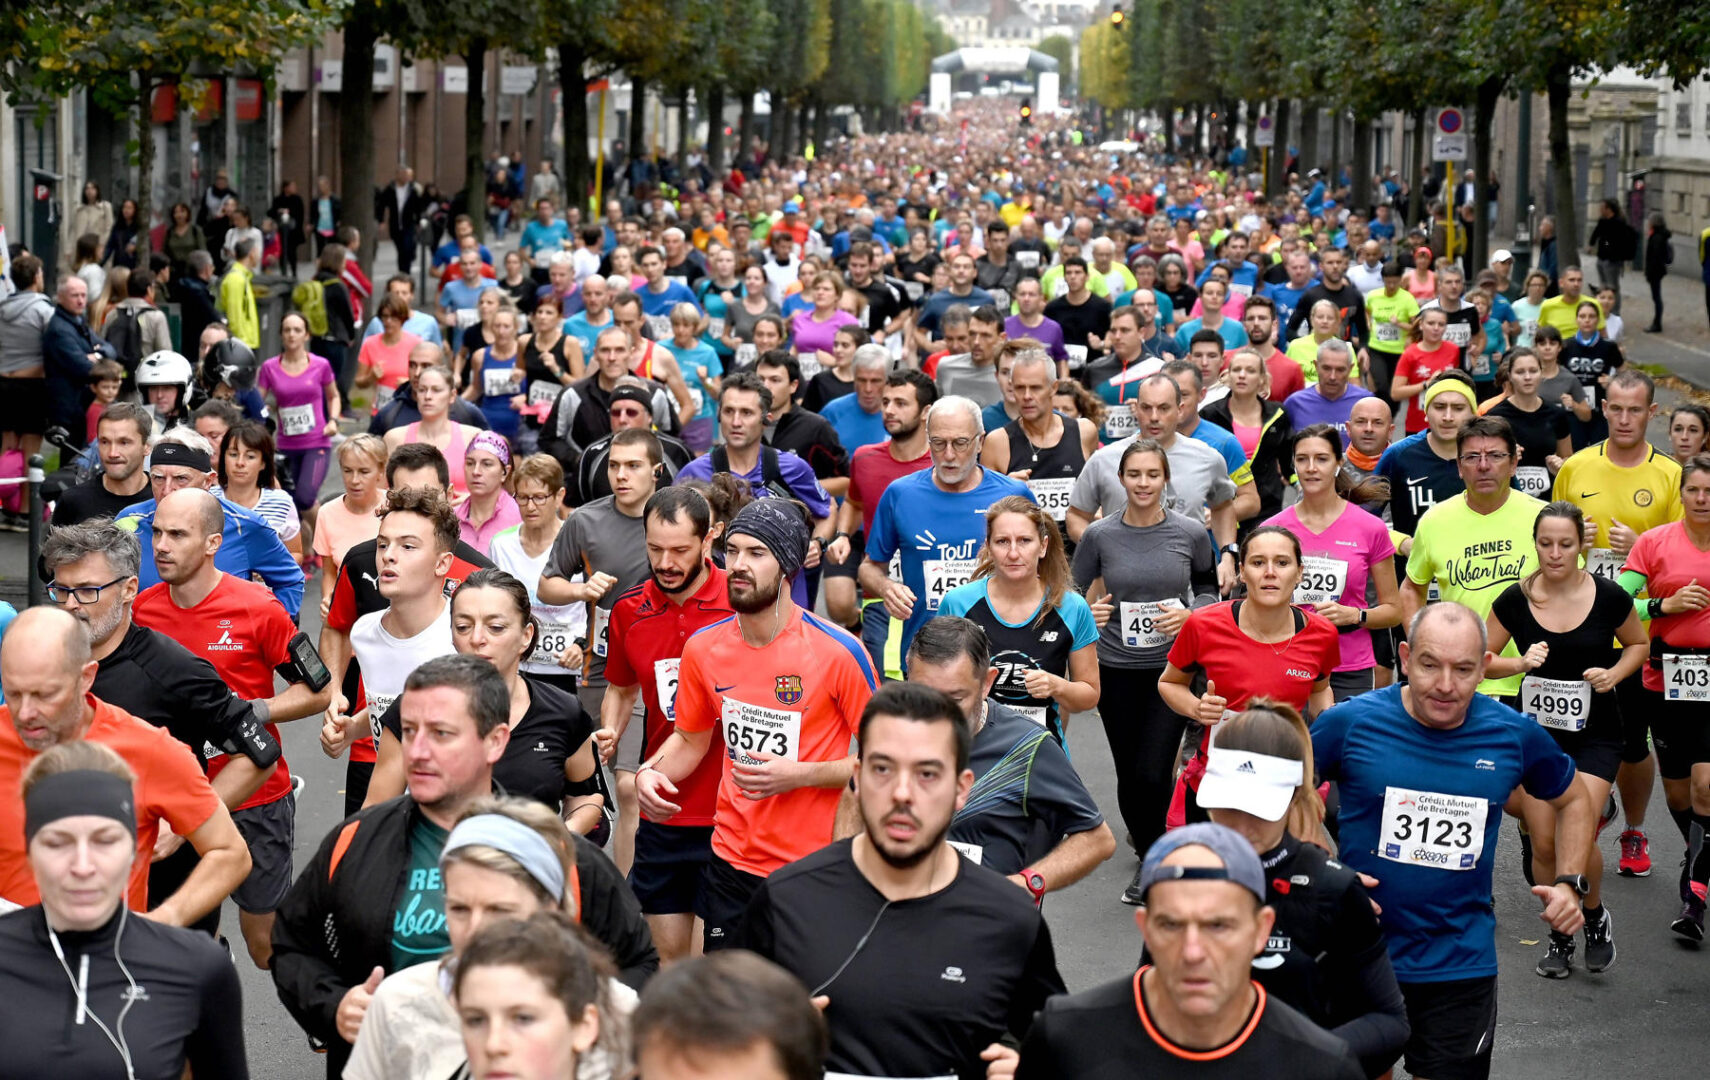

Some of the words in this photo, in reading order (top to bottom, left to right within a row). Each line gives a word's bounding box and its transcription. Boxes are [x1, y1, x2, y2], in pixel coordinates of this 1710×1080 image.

[1408, 485, 1437, 515] 14
[1464, 539, 1512, 558] RENNES
[1446, 556, 1491, 588] Urban
[1481, 553, 1526, 580] Trail
[1293, 573, 1337, 592] 529
[1129, 617, 1154, 635] 49
[377, 696, 395, 705] Crédi
[1530, 694, 1583, 716] 4999
[741, 714, 750, 722] de
[750, 716, 784, 729] Bretagne
[742, 705, 763, 717] Crédit
[763, 711, 792, 722] Mutuel
[728, 722, 789, 757] 6573
[1418, 804, 1429, 812] de
[1430, 806, 1470, 818] Bretagne
[1419, 795, 1446, 808] Crédit
[1447, 799, 1477, 809] Mutuel
[1394, 813, 1473, 849] 3123
